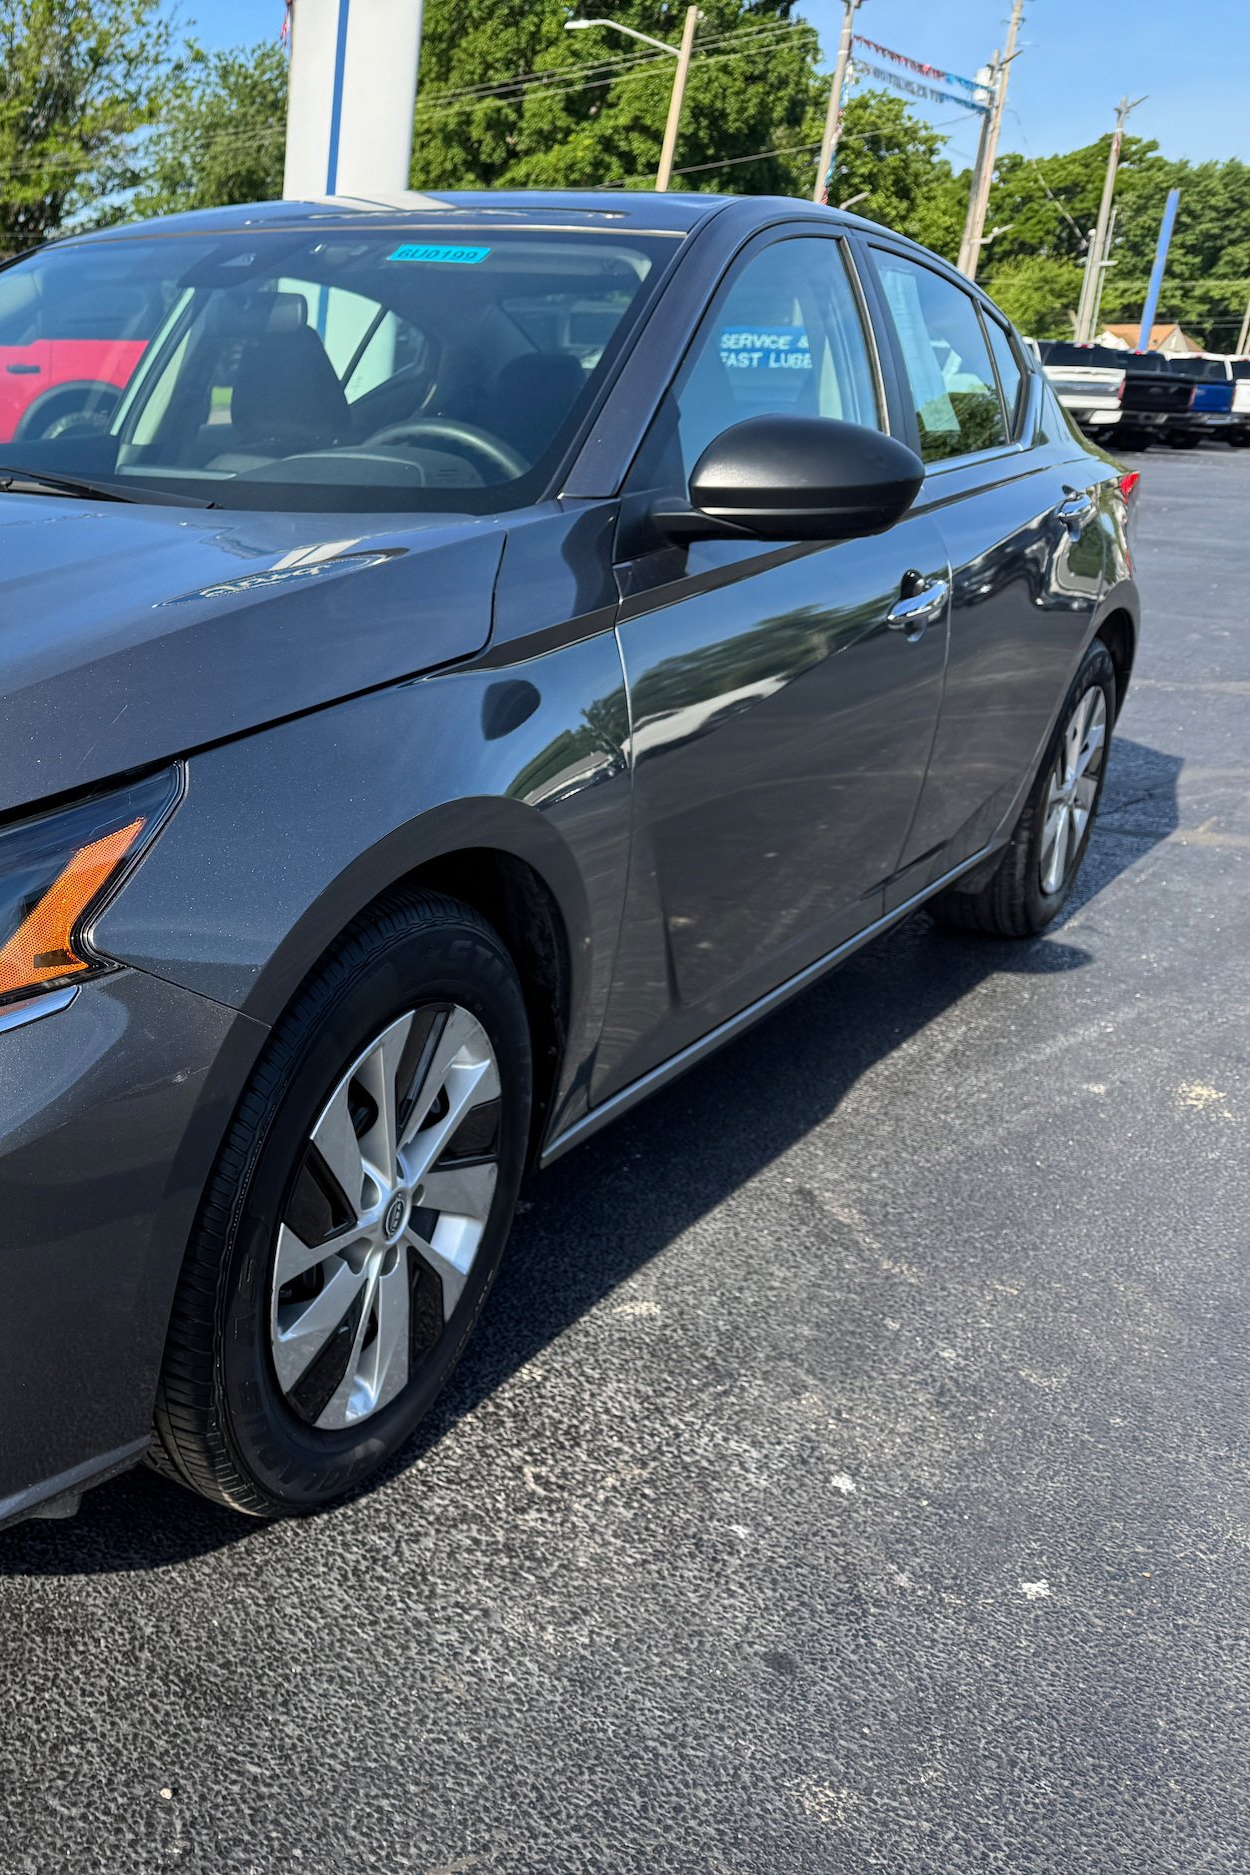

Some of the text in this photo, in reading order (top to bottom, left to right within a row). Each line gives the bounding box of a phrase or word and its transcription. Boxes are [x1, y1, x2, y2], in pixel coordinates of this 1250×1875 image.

[721, 333, 793, 350] SERVICE
[720, 352, 812, 368] FAST LUBE
